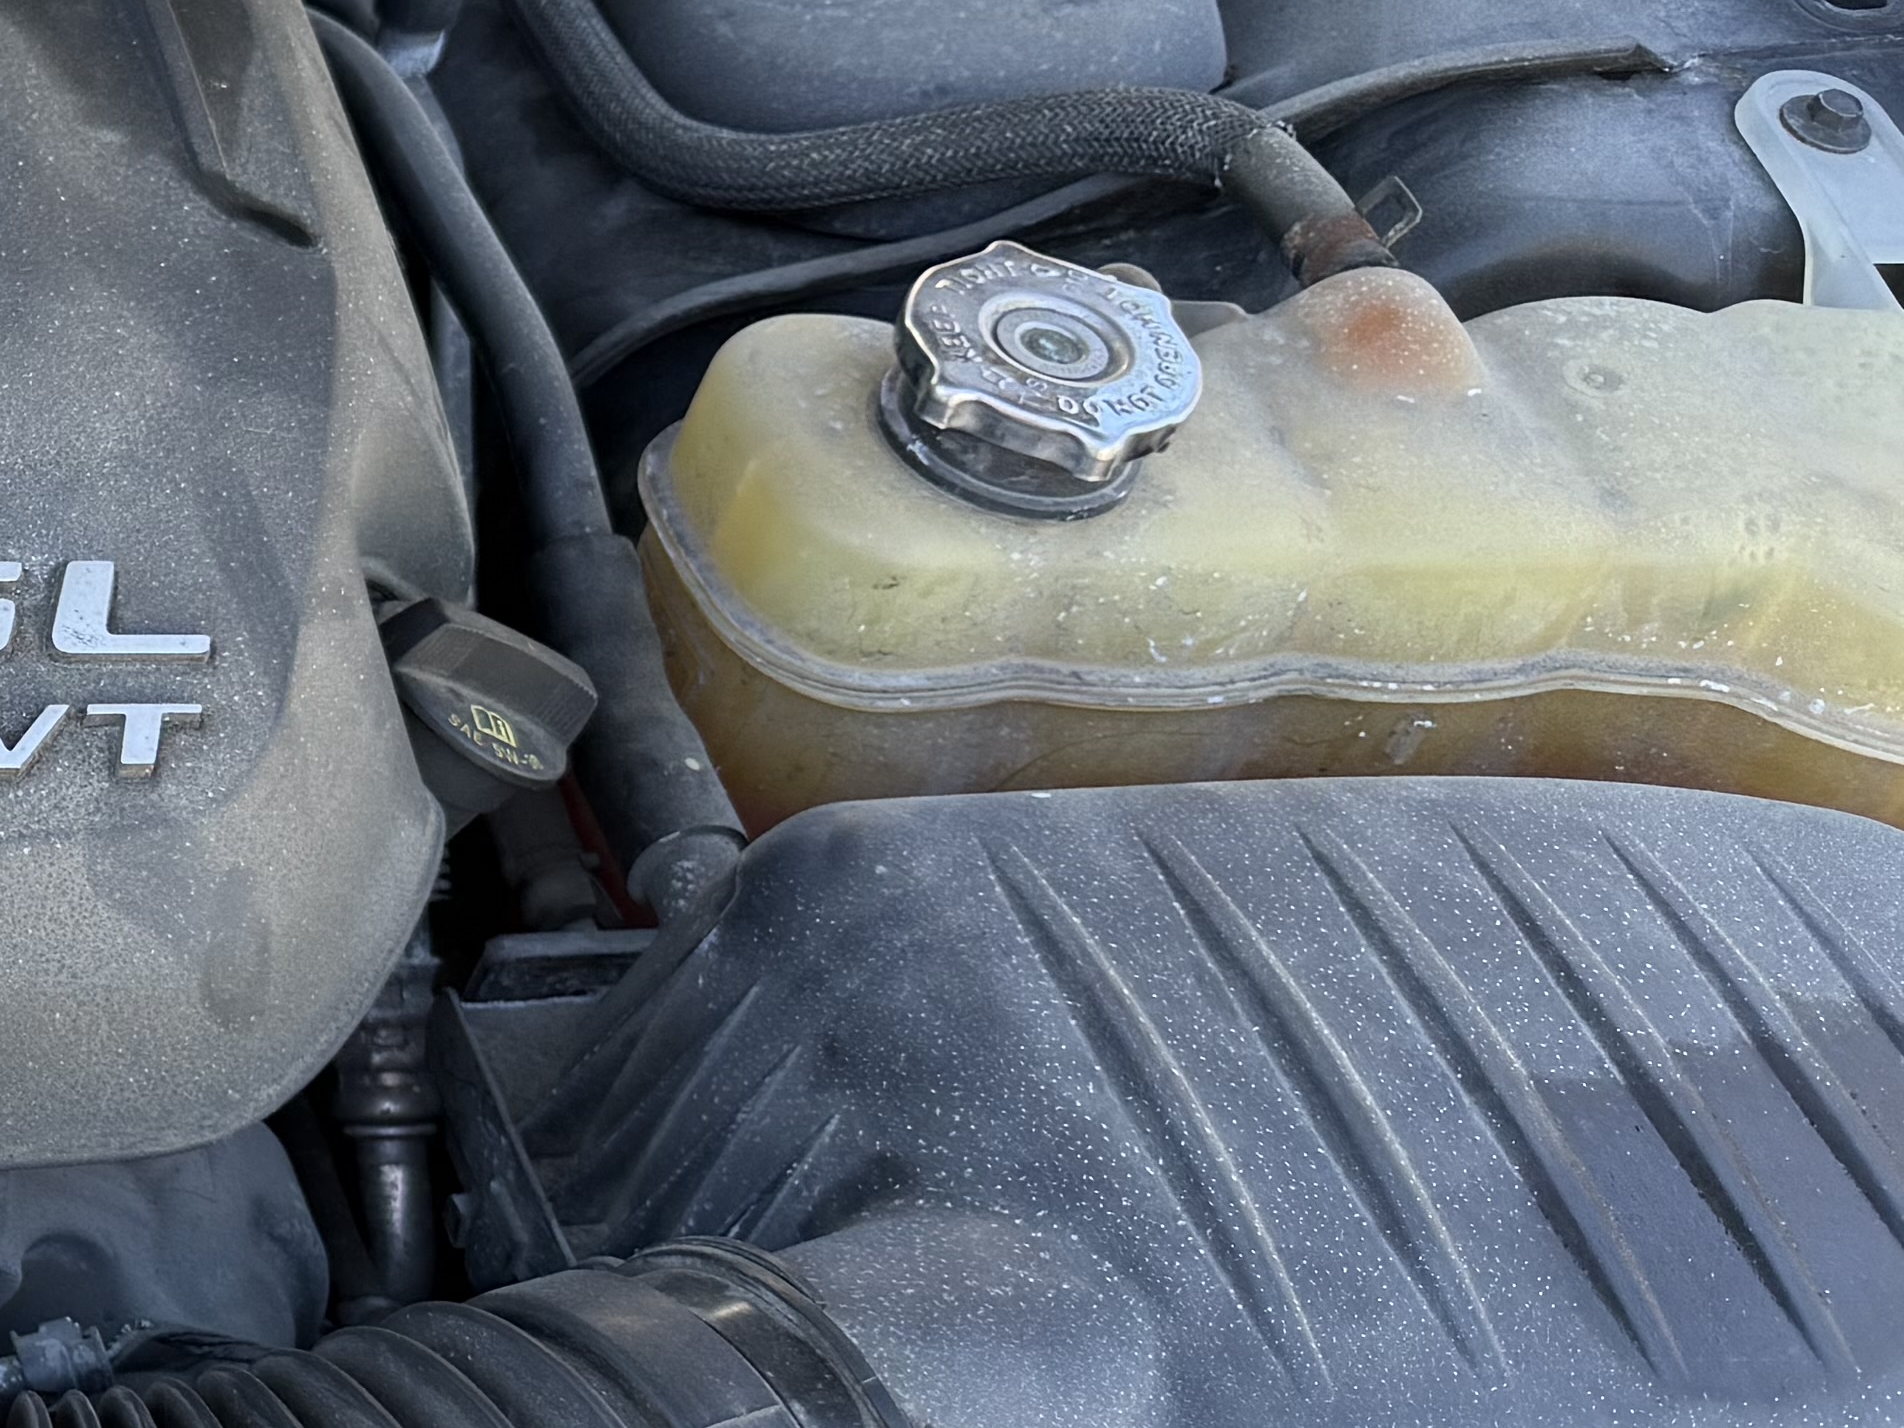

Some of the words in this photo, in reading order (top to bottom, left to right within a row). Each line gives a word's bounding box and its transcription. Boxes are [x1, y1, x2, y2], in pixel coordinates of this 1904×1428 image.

[935, 260, 1015, 295] TIGHT
[928, 303, 983, 363] KEEP
[1056, 393, 1102, 418] DO
[1102, 386, 1165, 417] NOT
[1148, 330, 1184, 391] OPEN
[448, 713, 484, 747] SAE
